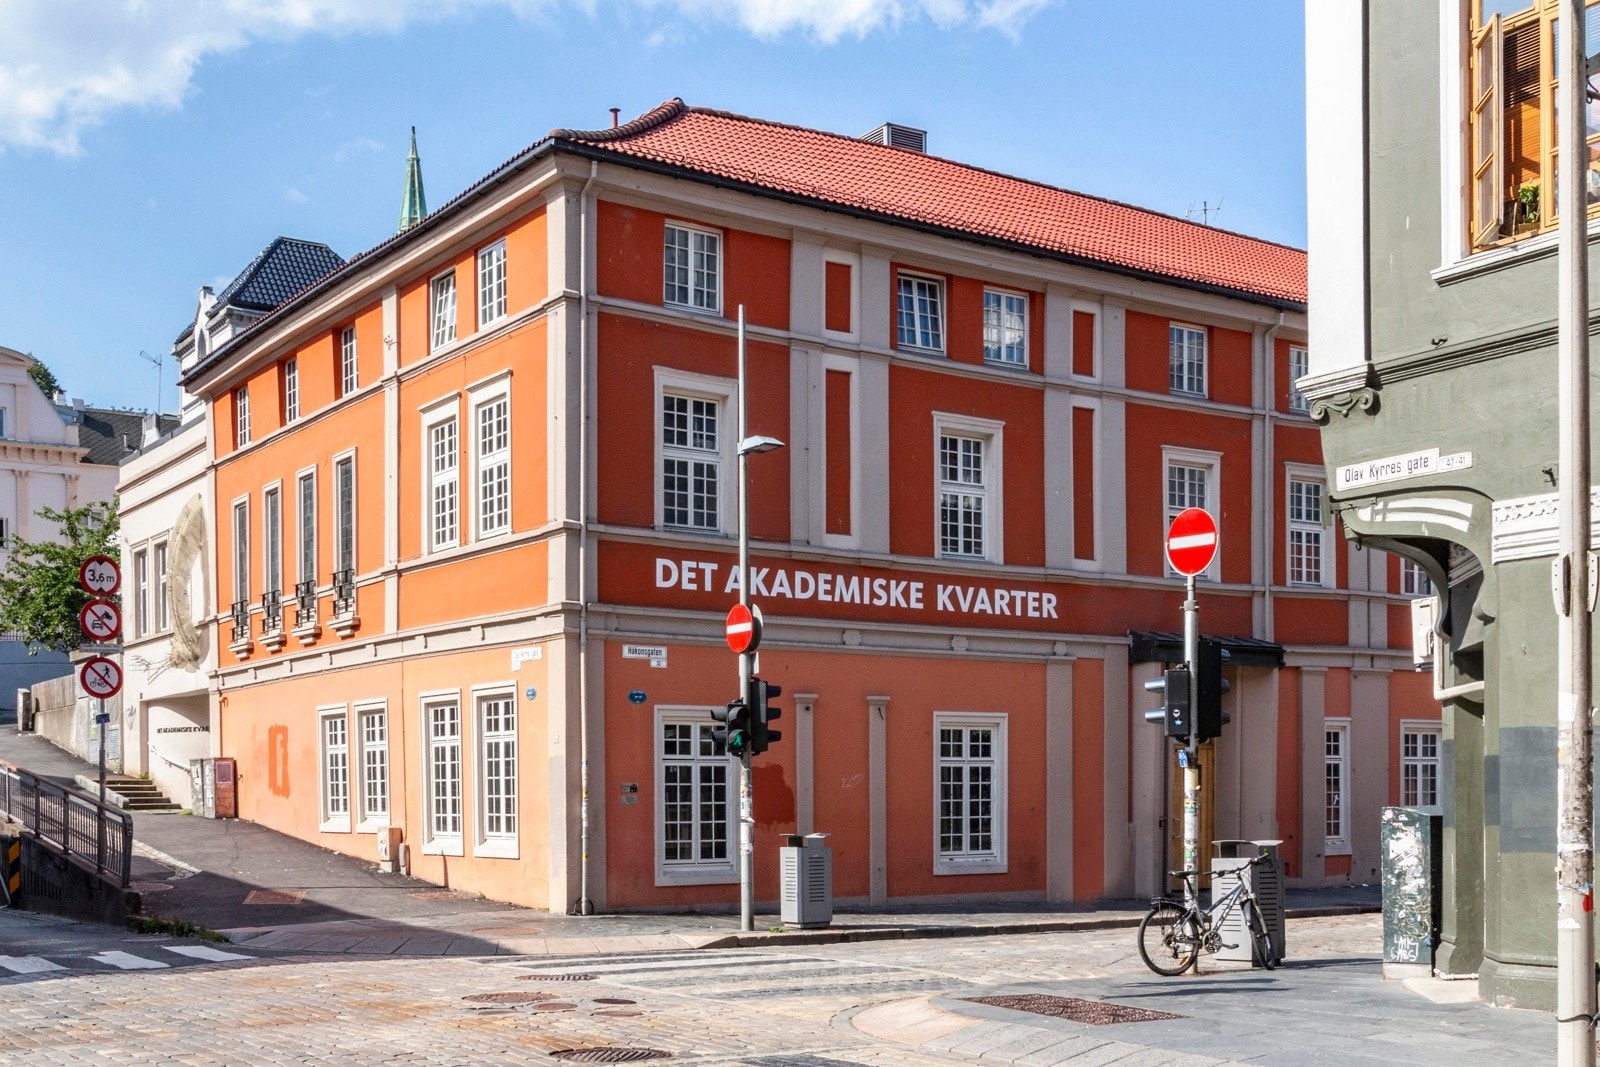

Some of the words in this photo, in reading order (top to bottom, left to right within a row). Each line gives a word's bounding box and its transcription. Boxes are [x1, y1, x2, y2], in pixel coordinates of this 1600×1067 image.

[1345, 468, 1364, 482] Olav
[1369, 462, 1402, 480] Kyrres
[1407, 456, 1429, 474] gate
[88, 569, 105, 583] 3,6
[655, 557, 719, 592] DET
[724, 564, 924, 610] AKADEMISKE
[936, 583, 1059, 619] KVARTER
[627, 646, 663, 657] Håkonsgaten
